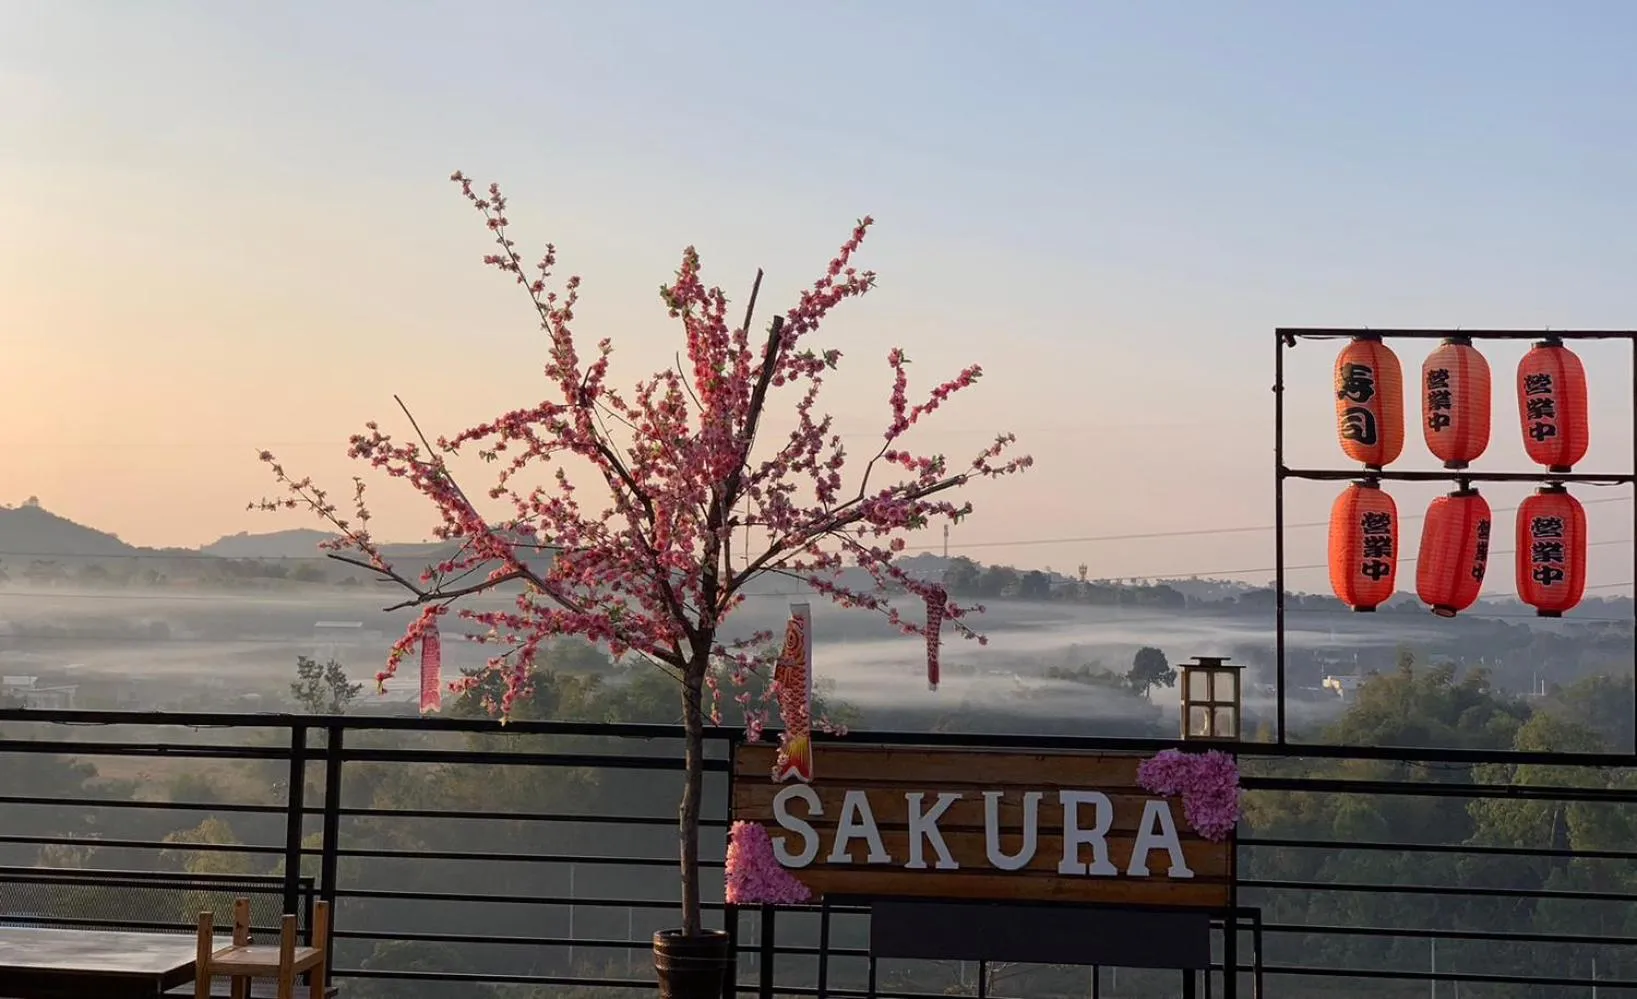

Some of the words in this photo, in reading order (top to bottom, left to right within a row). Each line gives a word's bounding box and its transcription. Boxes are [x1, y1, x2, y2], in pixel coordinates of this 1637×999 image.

[1428, 369, 1452, 431] 営業中
[1525, 374, 1556, 441] 営業中
[1361, 512, 1392, 580] 営業中
[1531, 517, 1564, 584] 営業中
[772, 784, 1194, 878] SAKURA
